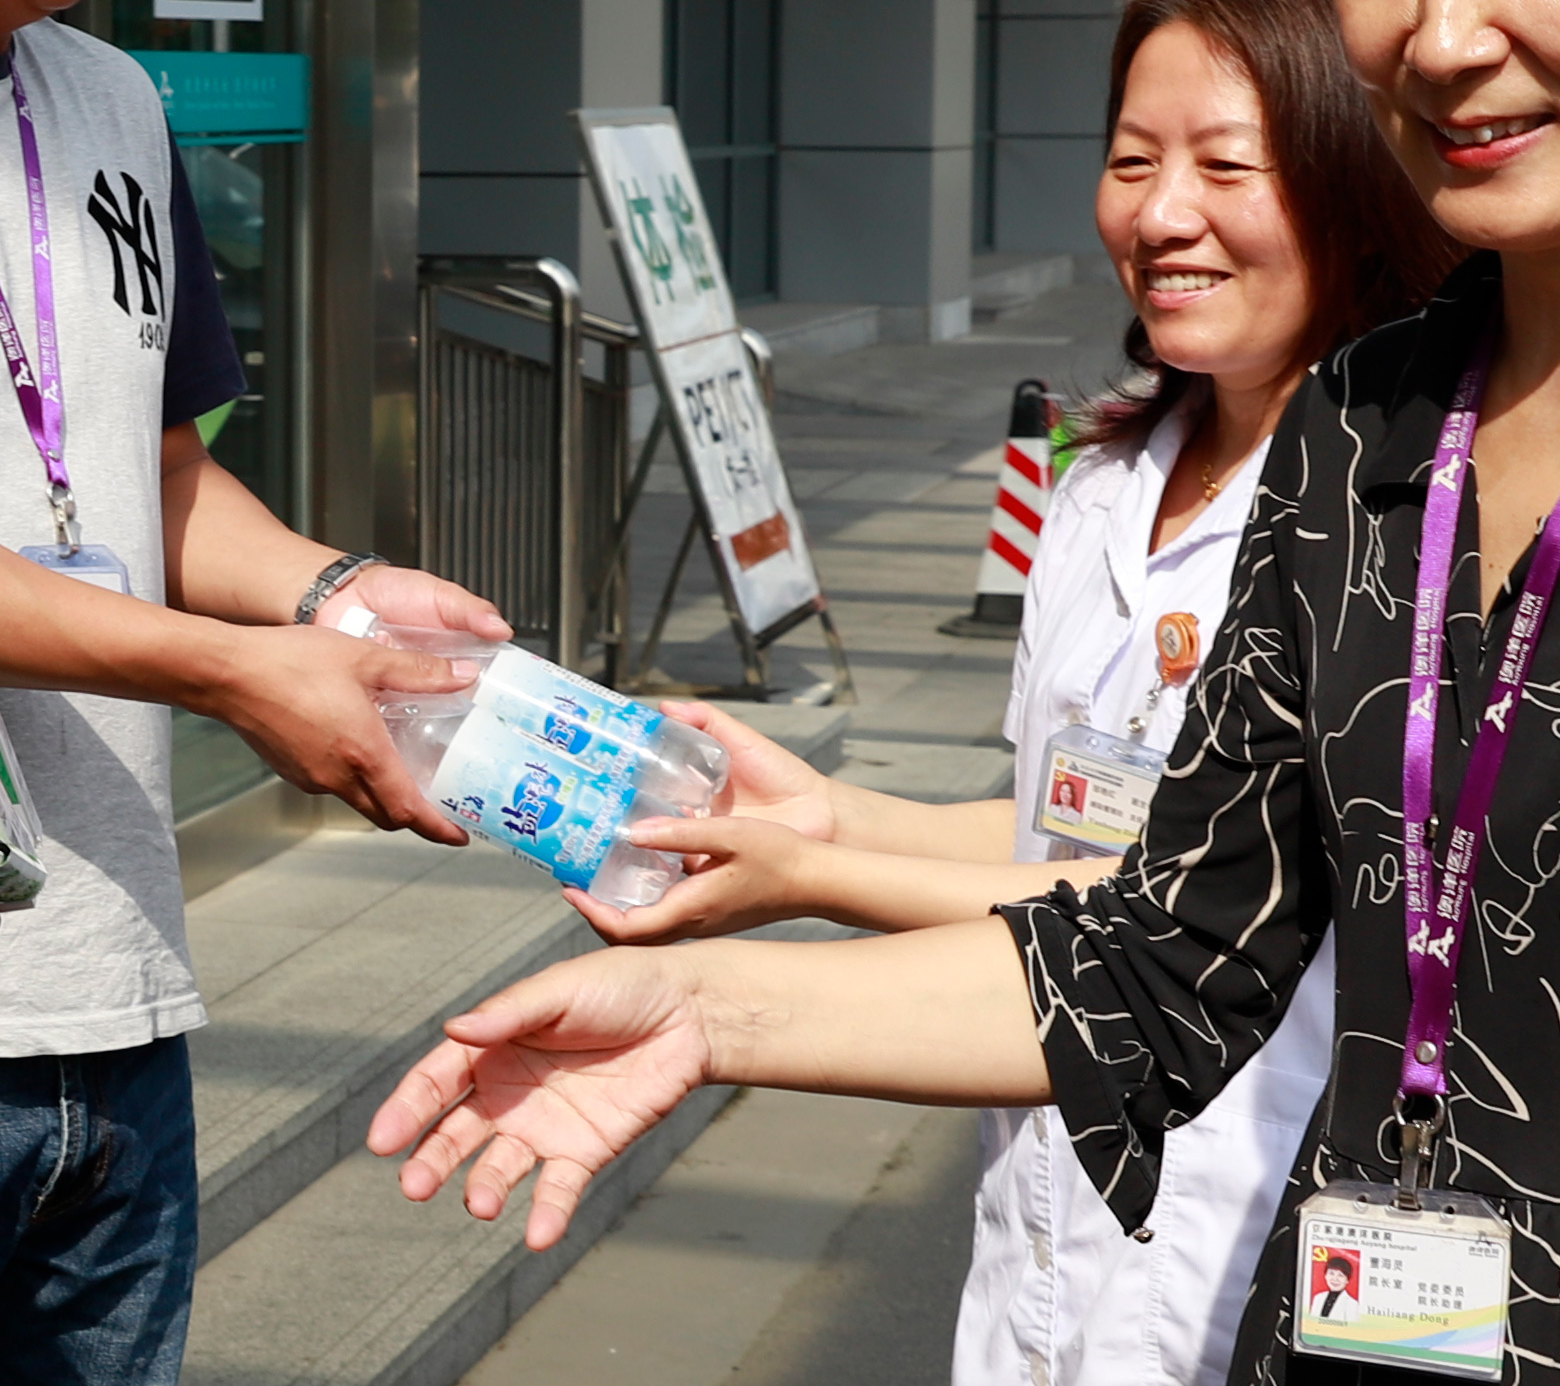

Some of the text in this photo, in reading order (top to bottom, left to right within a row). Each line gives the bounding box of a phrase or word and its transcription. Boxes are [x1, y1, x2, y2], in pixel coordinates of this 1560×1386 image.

[1414, 587, 1433, 675] 澳洋医院
[1498, 590, 1536, 684] 澳洋医院
[1435, 824, 1469, 918] 澳洋医院
[1367, 1305, 1416, 1323] Hailiang
[1419, 1312, 1450, 1326] Dong
